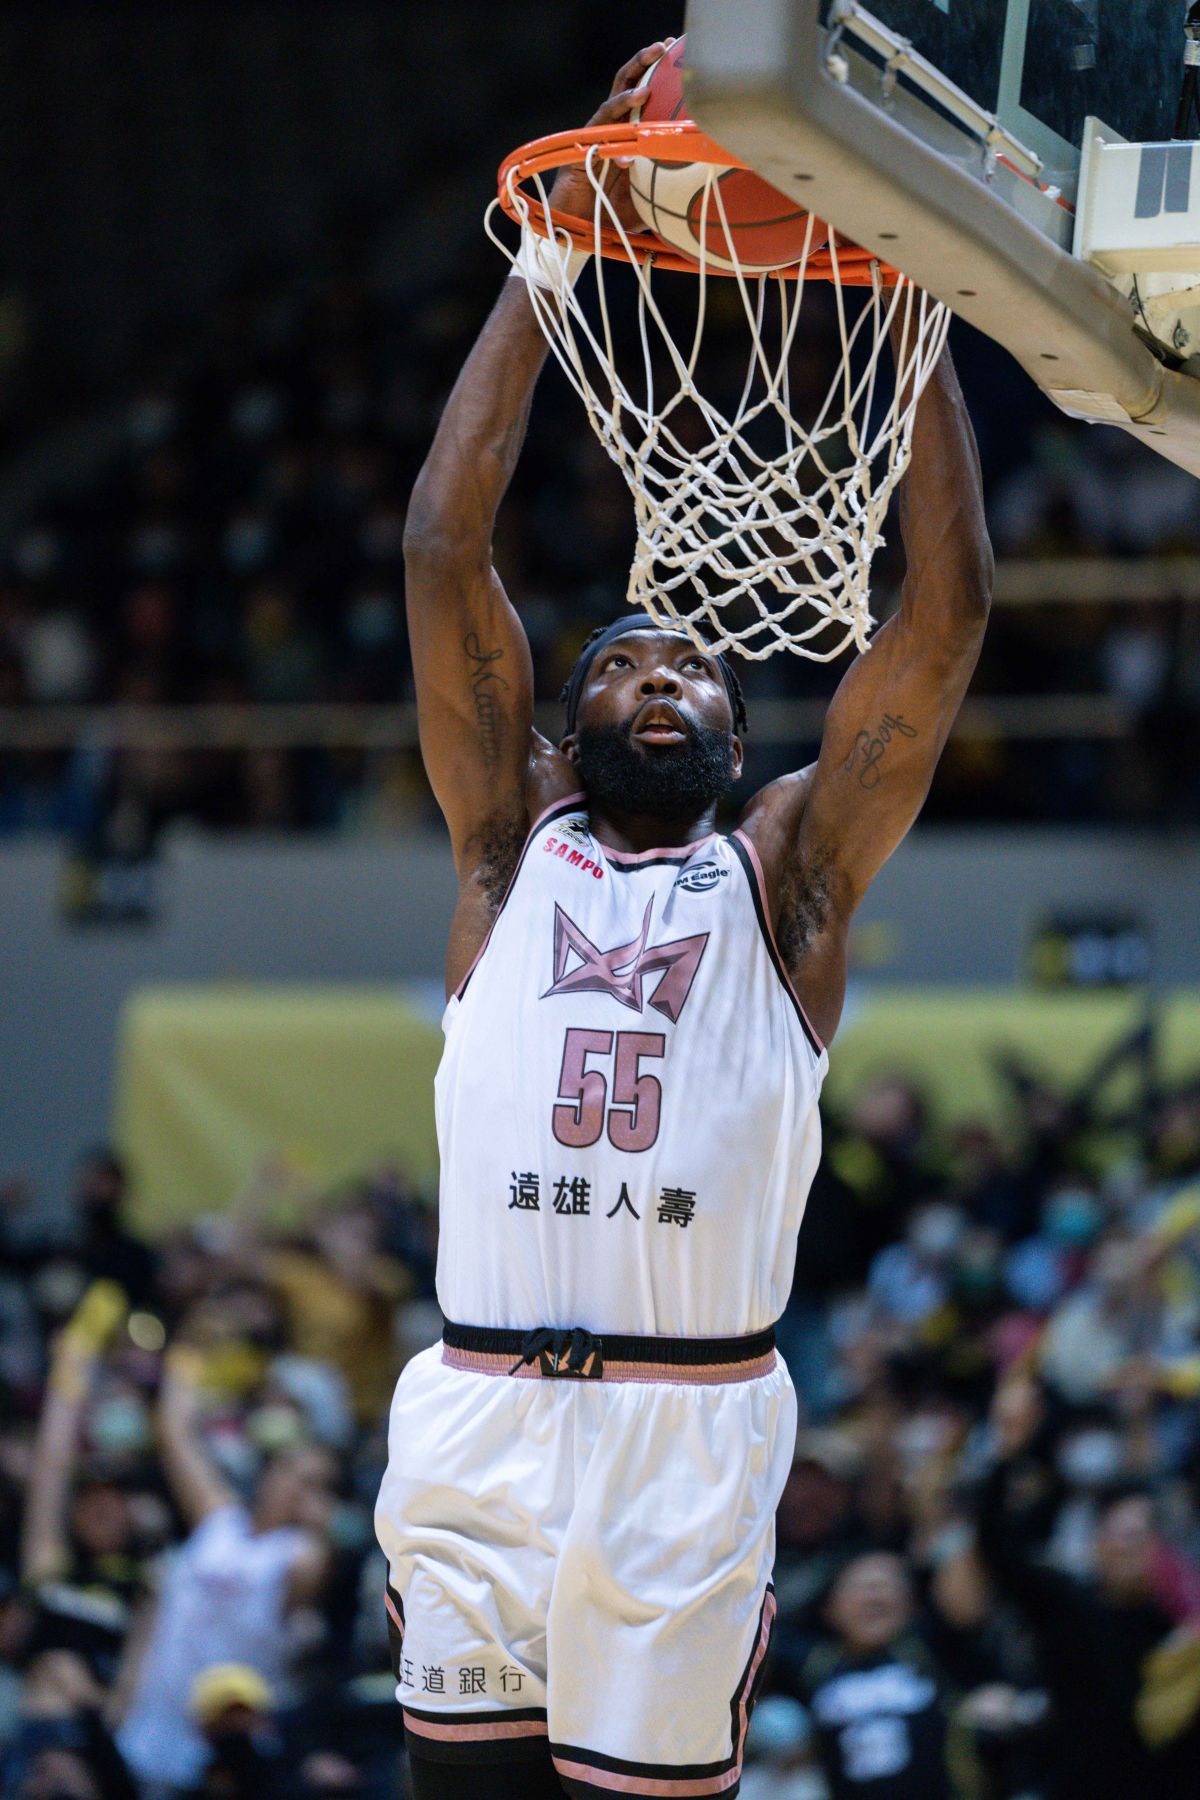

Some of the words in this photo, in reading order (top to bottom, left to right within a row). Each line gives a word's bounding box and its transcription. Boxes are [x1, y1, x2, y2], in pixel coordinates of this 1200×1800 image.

[840, 713, 918, 790] Boy
[543, 837, 604, 879] SAMPO
[691, 868, 728, 881] Eagle
[552, 1027, 666, 1153] 55
[508, 1171, 697, 1228] 遠雄人壽
[404, 1659, 526, 1694] 王道銀行
